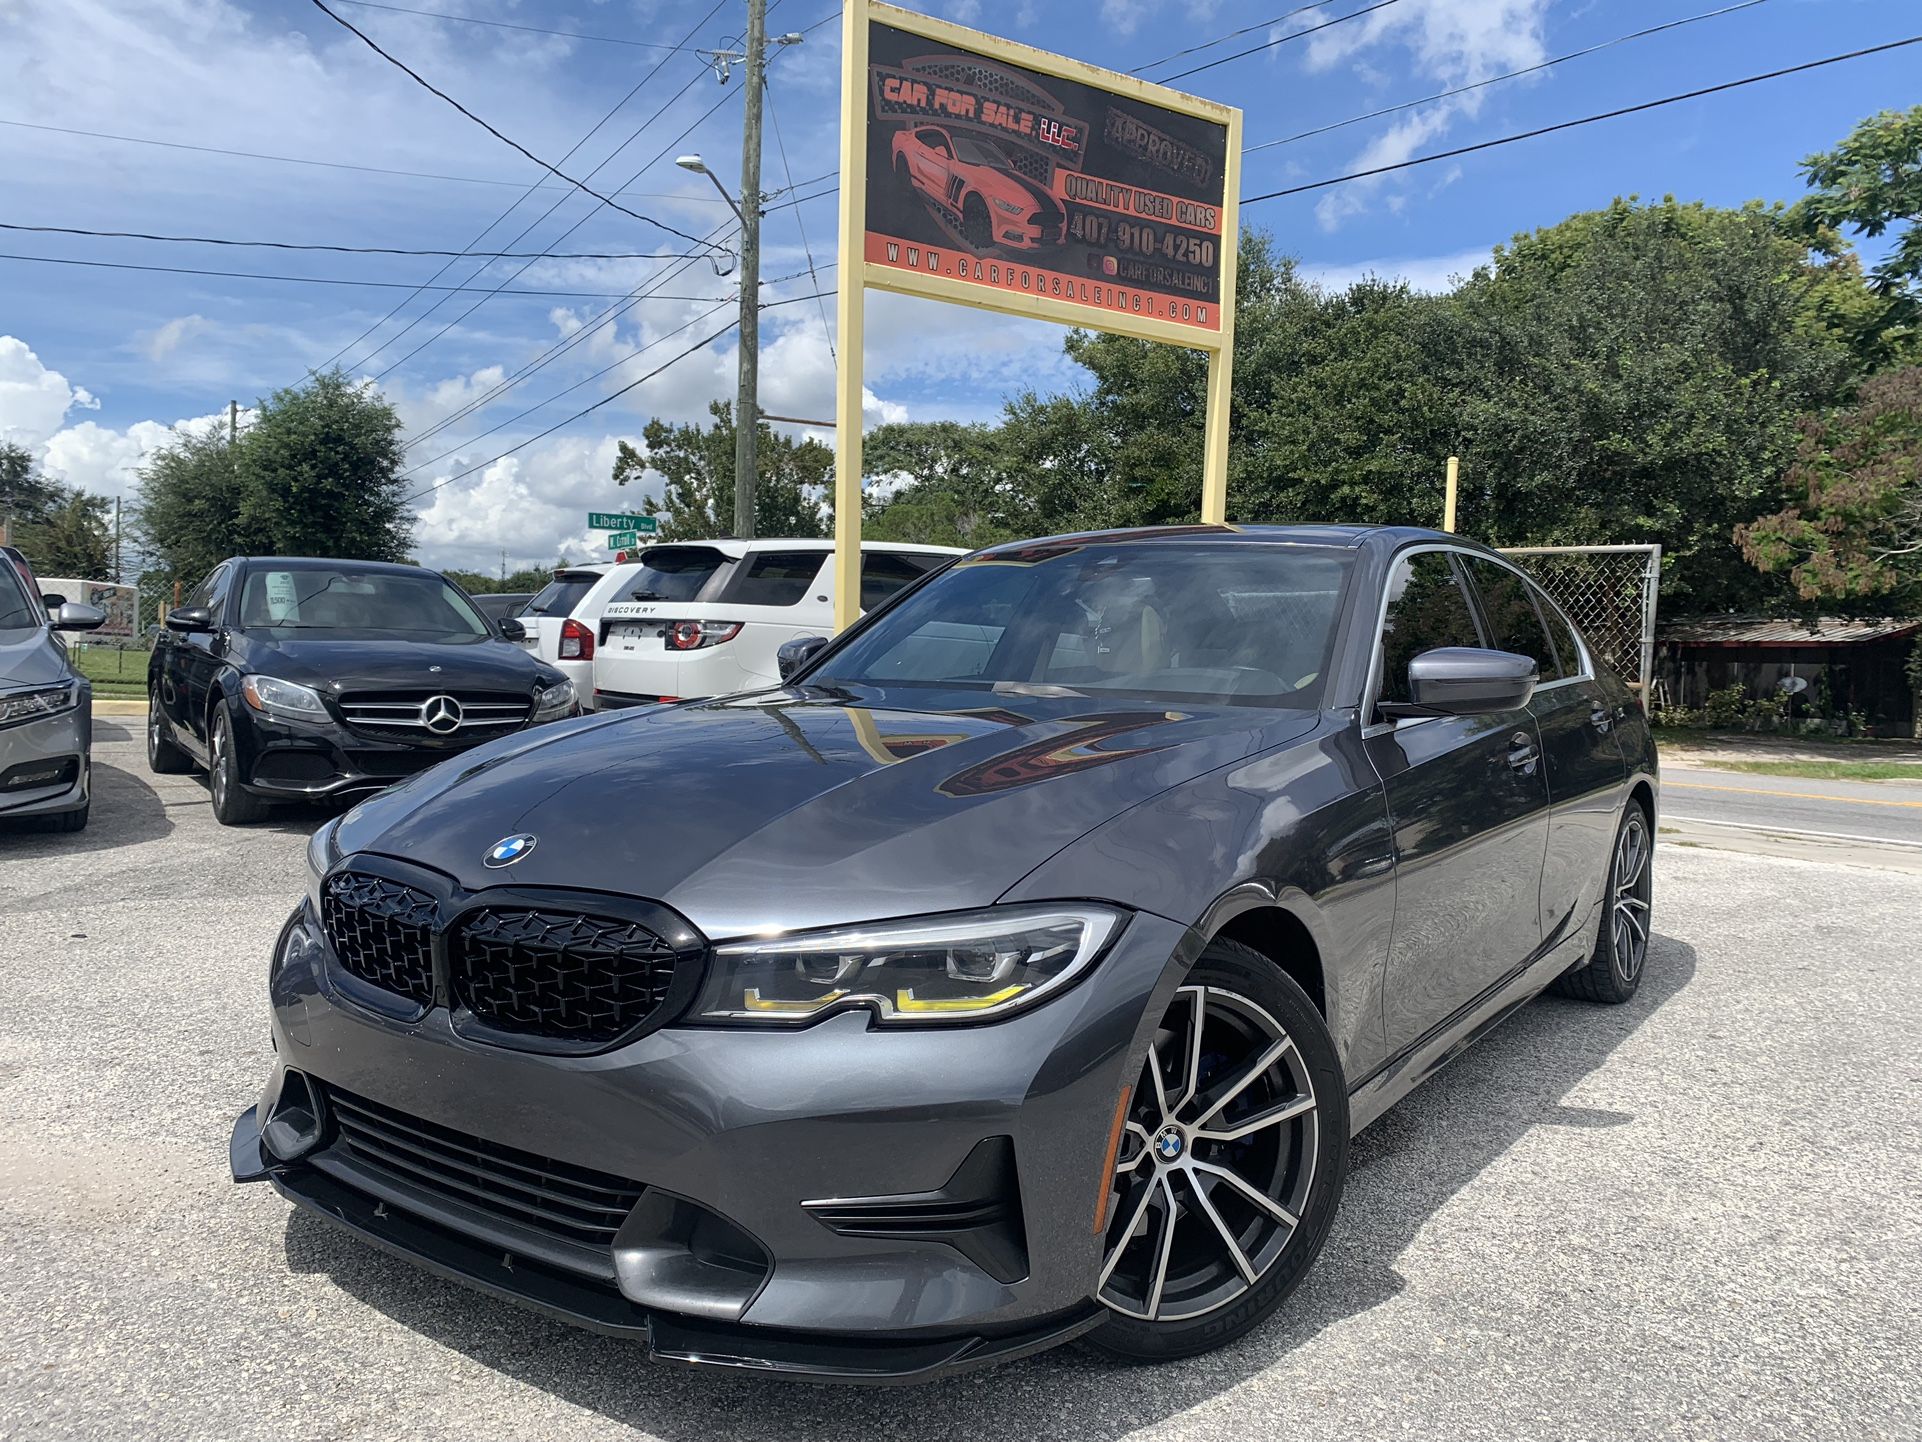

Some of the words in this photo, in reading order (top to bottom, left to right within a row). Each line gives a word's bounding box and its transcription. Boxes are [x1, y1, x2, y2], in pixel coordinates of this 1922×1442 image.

[883, 78, 928, 108] CAR
[933, 88, 976, 118] FOR
[1065, 173, 1132, 211] QUALITY
[1134, 191, 1174, 221] USED
[1176, 200, 1216, 230] CARS
[1070, 211, 1214, 268] 407-910-4250
[1119, 256, 1213, 295] CARFORSALEINC1
[592, 514, 635, 531] Liberty
[640, 522, 653, 530] Blvd
[608, 606, 656, 614] DISCOVERY
[1155, 1127, 1178, 1149] BMW
